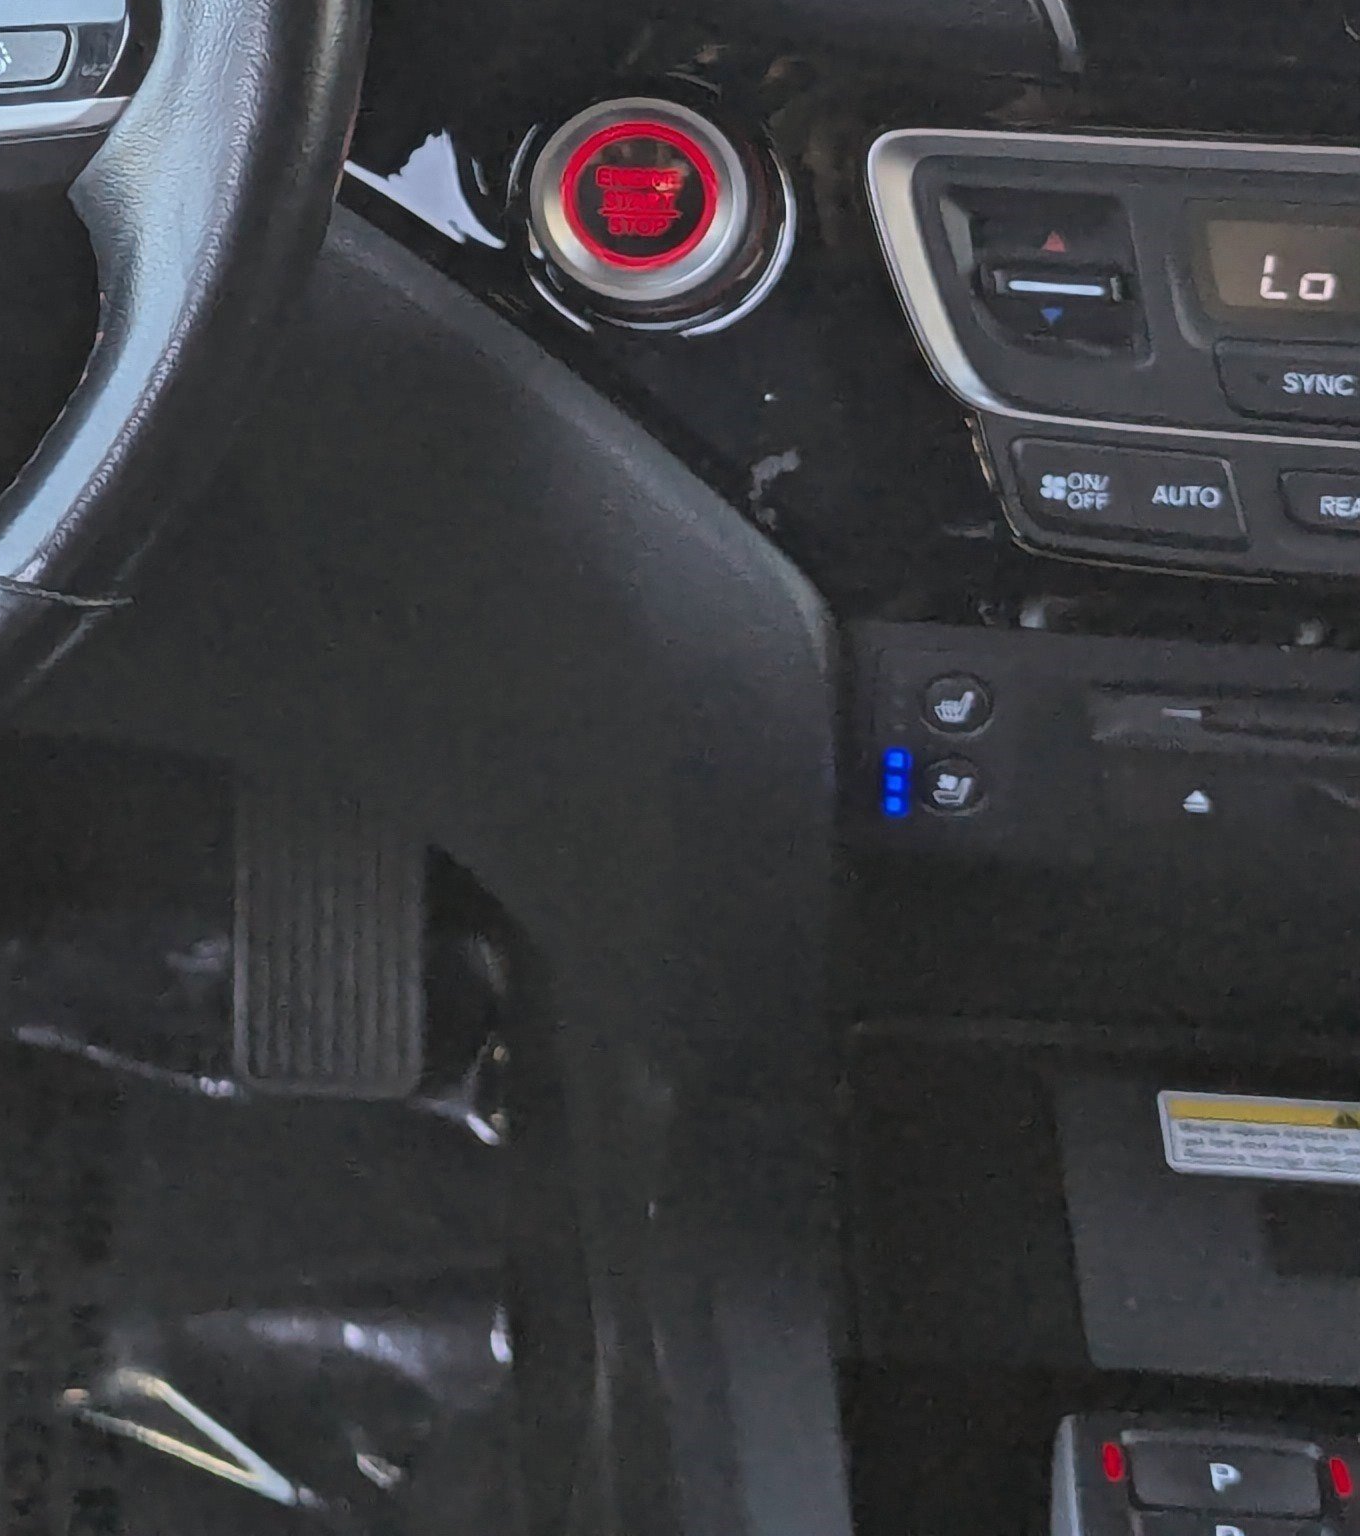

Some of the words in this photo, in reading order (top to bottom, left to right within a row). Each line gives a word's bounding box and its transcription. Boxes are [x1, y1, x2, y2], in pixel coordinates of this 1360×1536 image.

[608, 216, 670, 237] STOP
[1259, 254, 1337, 302] Lo
[1281, 371, 1356, 397] SYNC
[1067, 491, 1111, 511] OFF
[1151, 485, 1223, 509] AUTO
[1209, 1462, 1242, 1493] P
